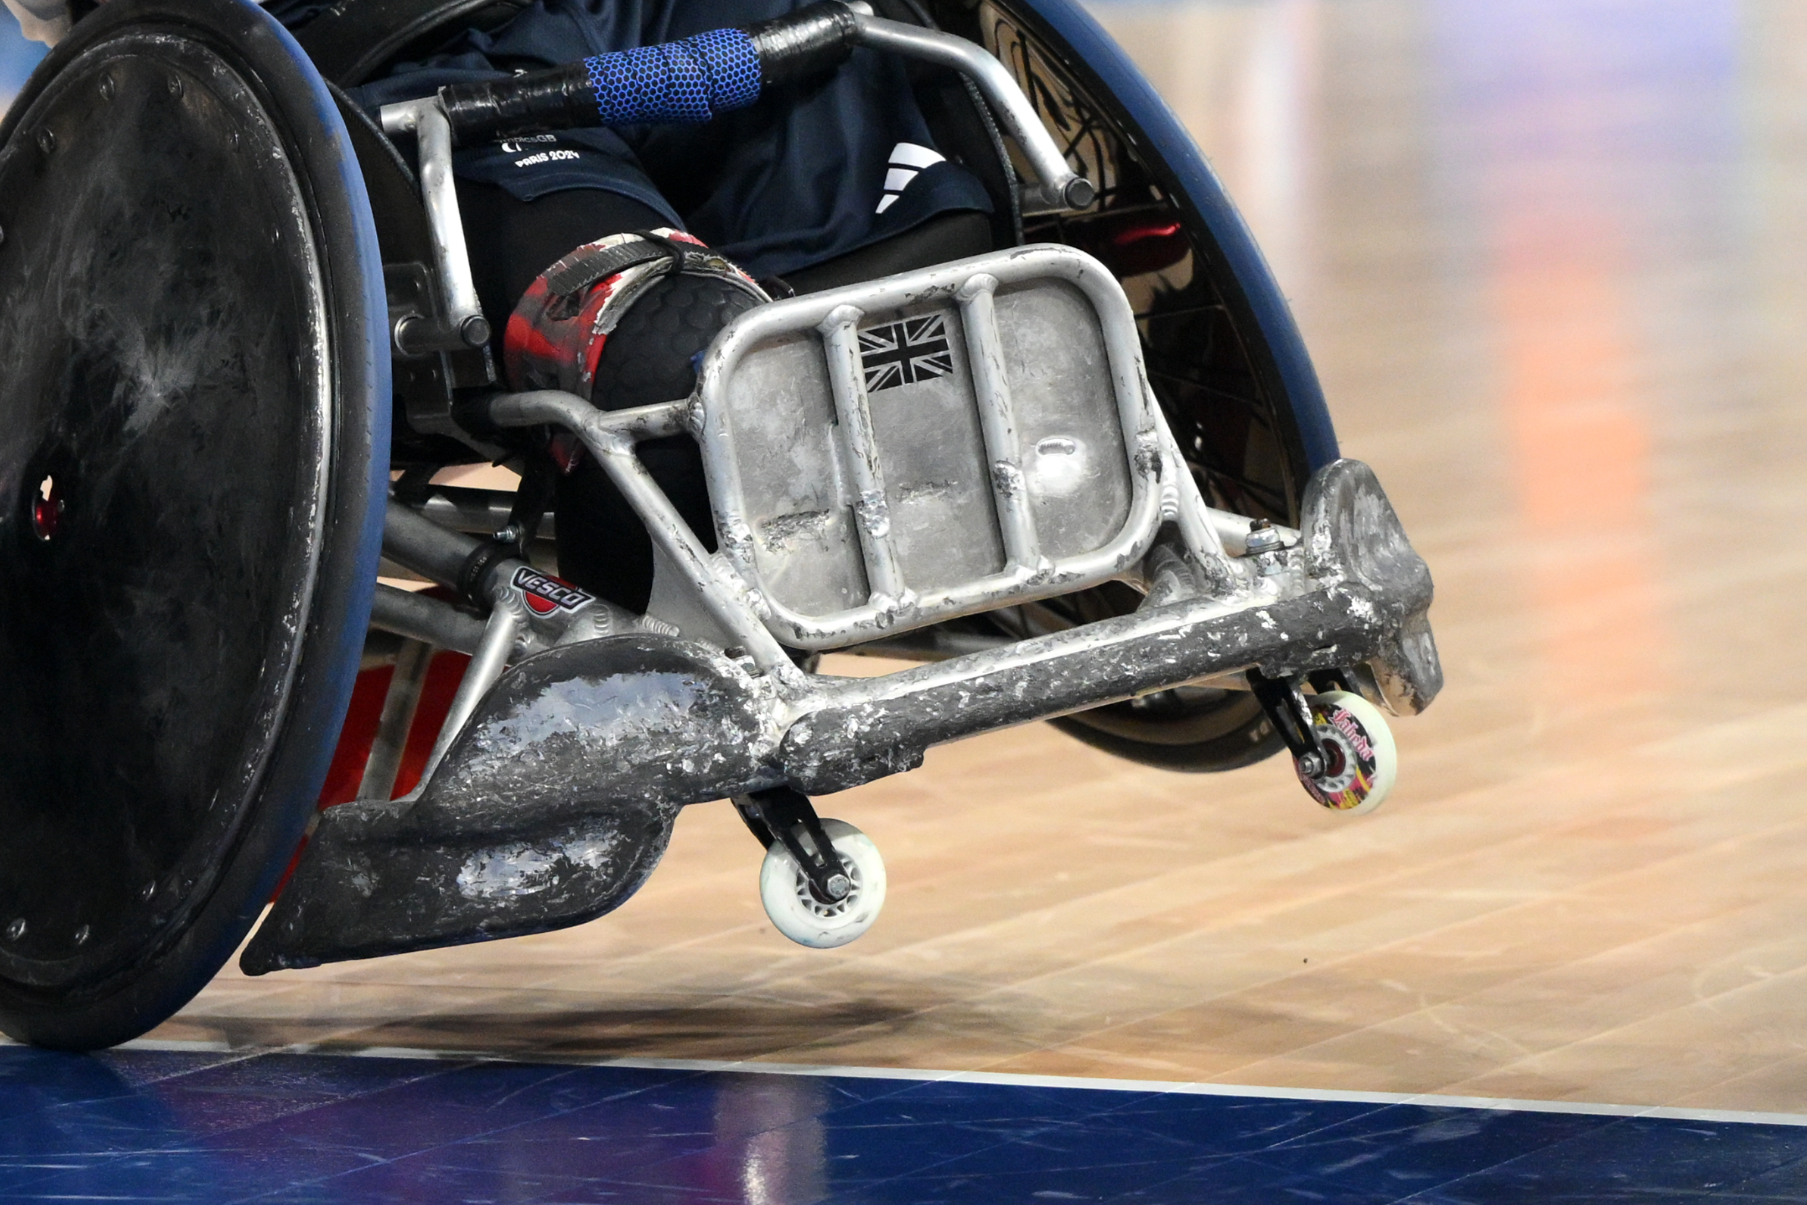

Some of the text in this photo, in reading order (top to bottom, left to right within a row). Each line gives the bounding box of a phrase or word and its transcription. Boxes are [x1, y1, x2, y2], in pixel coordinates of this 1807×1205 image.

[515, 150, 580, 168] PARIS 2024
[516, 570, 586, 606] VESCO
